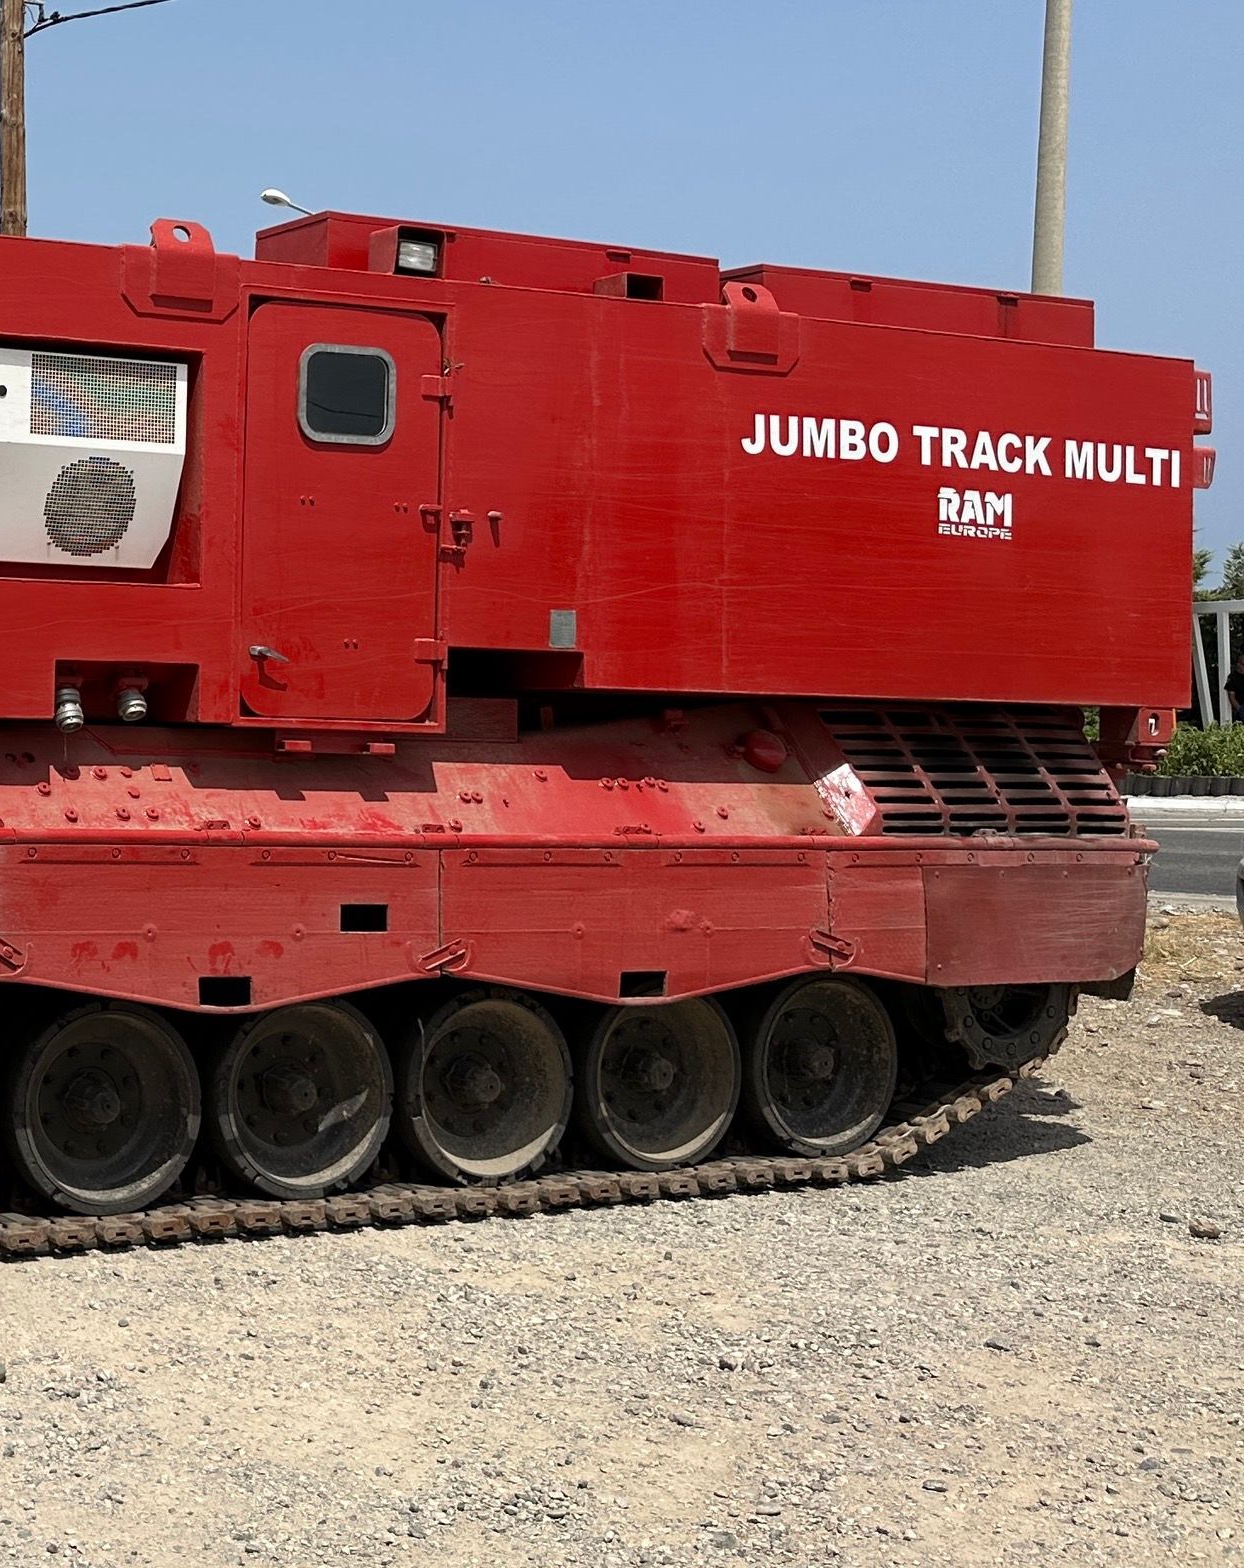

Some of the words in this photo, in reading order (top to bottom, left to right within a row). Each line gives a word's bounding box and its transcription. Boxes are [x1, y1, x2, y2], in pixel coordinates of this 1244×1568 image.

[741, 413, 899, 463] JUMBO
[912, 425, 1053, 476] TRACK
[1065, 439, 1181, 488] MULTI
[937, 486, 1013, 527] RAM
[938, 523, 1013, 540] EUROPE
